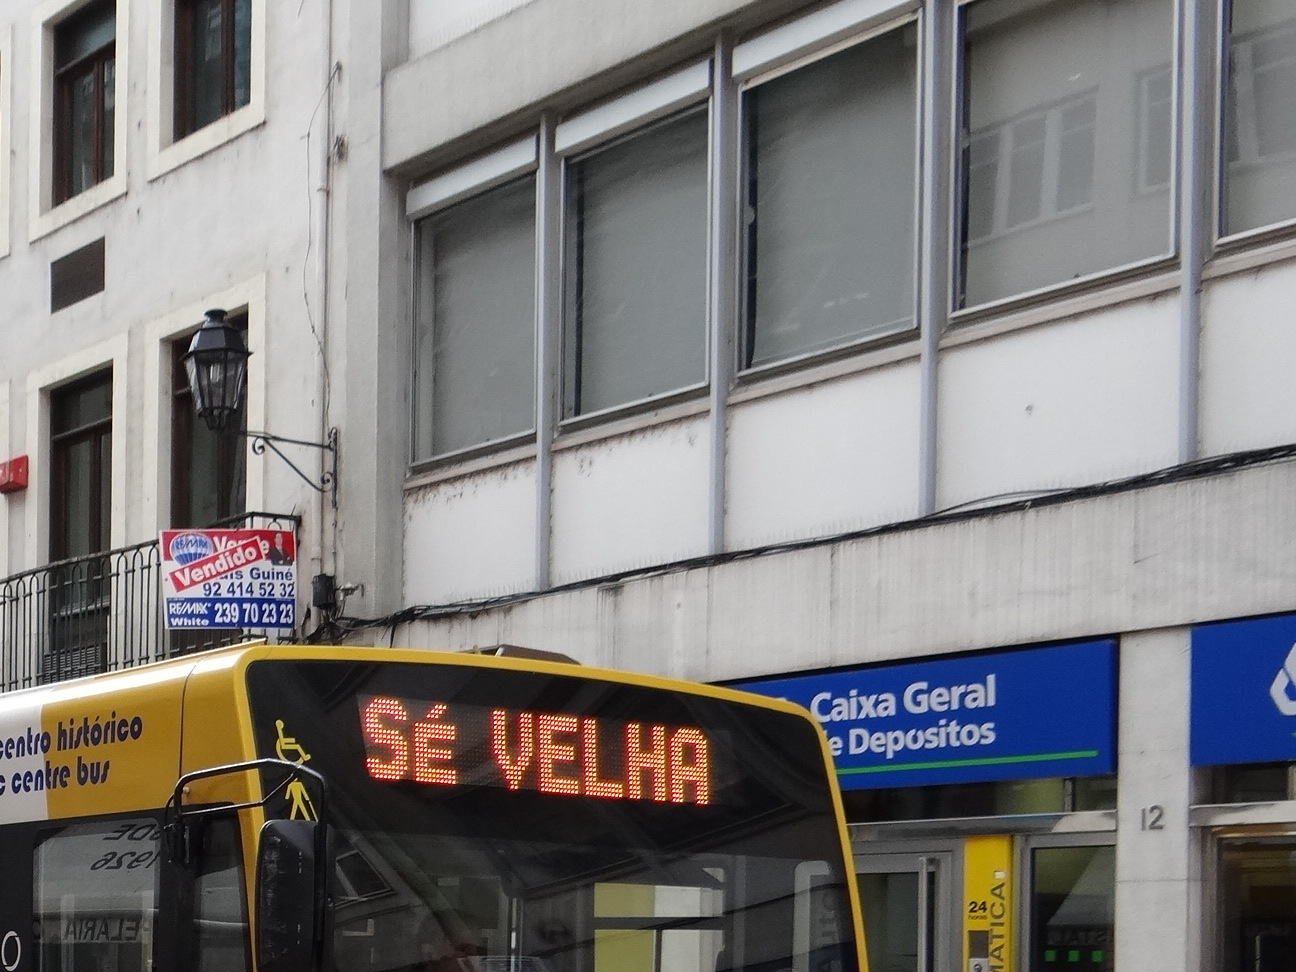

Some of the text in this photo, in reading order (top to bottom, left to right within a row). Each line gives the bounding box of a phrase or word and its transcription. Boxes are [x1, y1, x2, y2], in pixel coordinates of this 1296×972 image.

[174, 546, 257, 587] Vendido
[249, 567, 293, 581] Guiné
[203, 582, 295, 598] 92 414 52 32
[169, 602, 208, 615] RE/MAX
[214, 603, 294, 624] 239 70 23 23
[170, 617, 210, 627] White
[810, 673, 997, 723] Caixa Geral
[57, 710, 143, 752] histórico
[825, 730, 843, 757] e
[491, 709, 709, 806] VELHA
[11, 760, 71, 795] centre
[77, 756, 111, 786] bus
[1141, 805, 1165, 831] 12
[968, 901, 988, 913] 24
